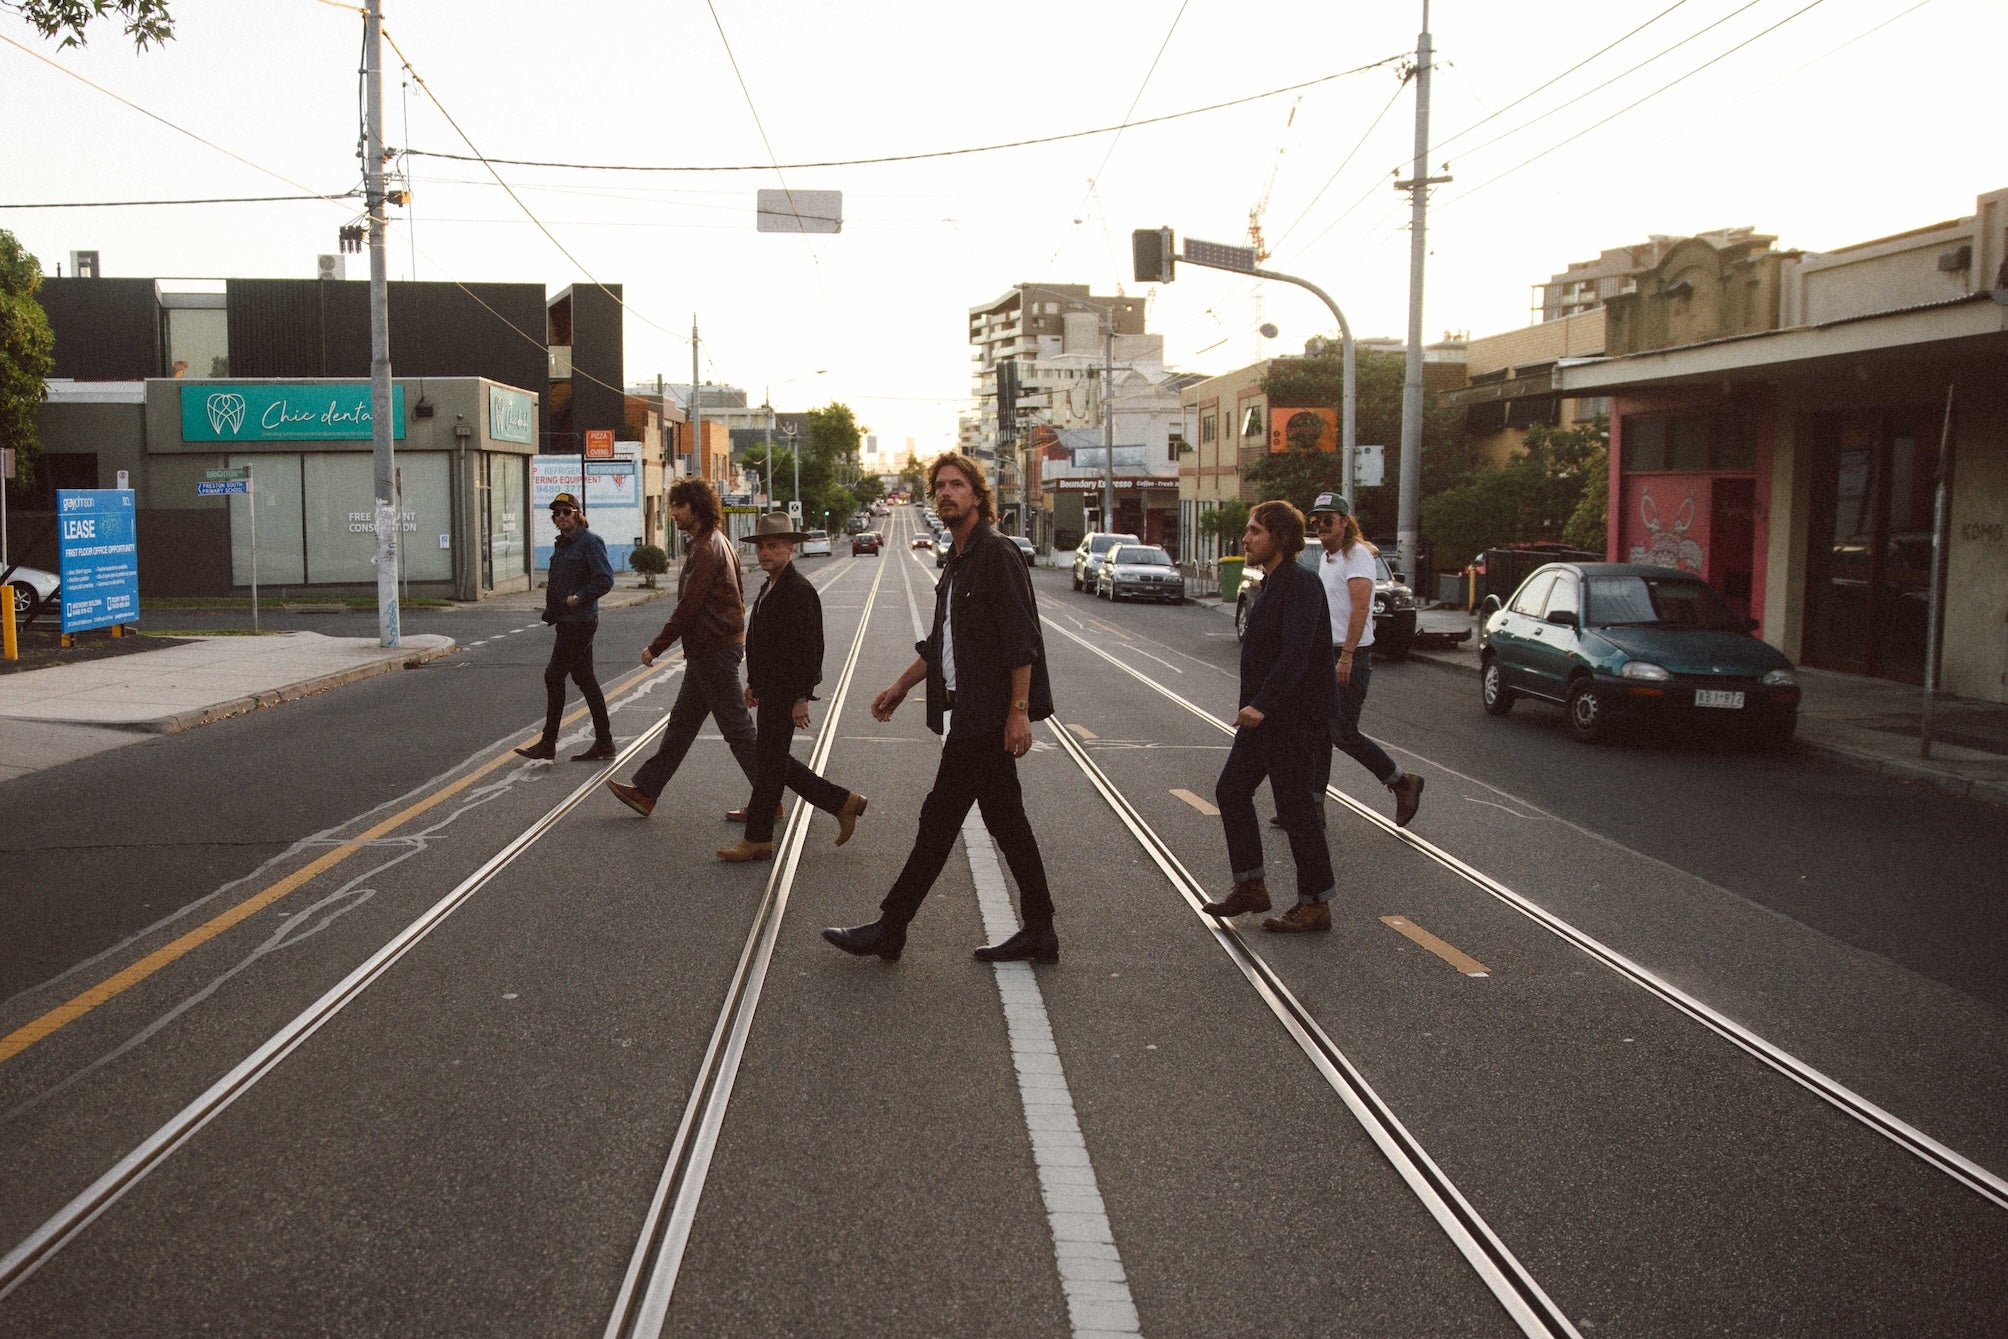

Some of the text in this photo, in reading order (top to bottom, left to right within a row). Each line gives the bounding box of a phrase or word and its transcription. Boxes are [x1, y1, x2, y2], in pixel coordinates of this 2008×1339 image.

[262, 400, 374, 429] Chic denta
[590, 432, 608, 440] PIZZA
[206, 470, 238, 479] BRIGHTON
[544, 467, 581, 475] REFRIGER
[1059, 479, 1097, 490] Boundary
[1098, 479, 1133, 488] Esresso
[349, 512, 371, 521] FREE
[64, 520, 96, 540] LEASE
[65, 544, 136, 558] FIRST FLOOR OFFICE OPPORTUNITY
